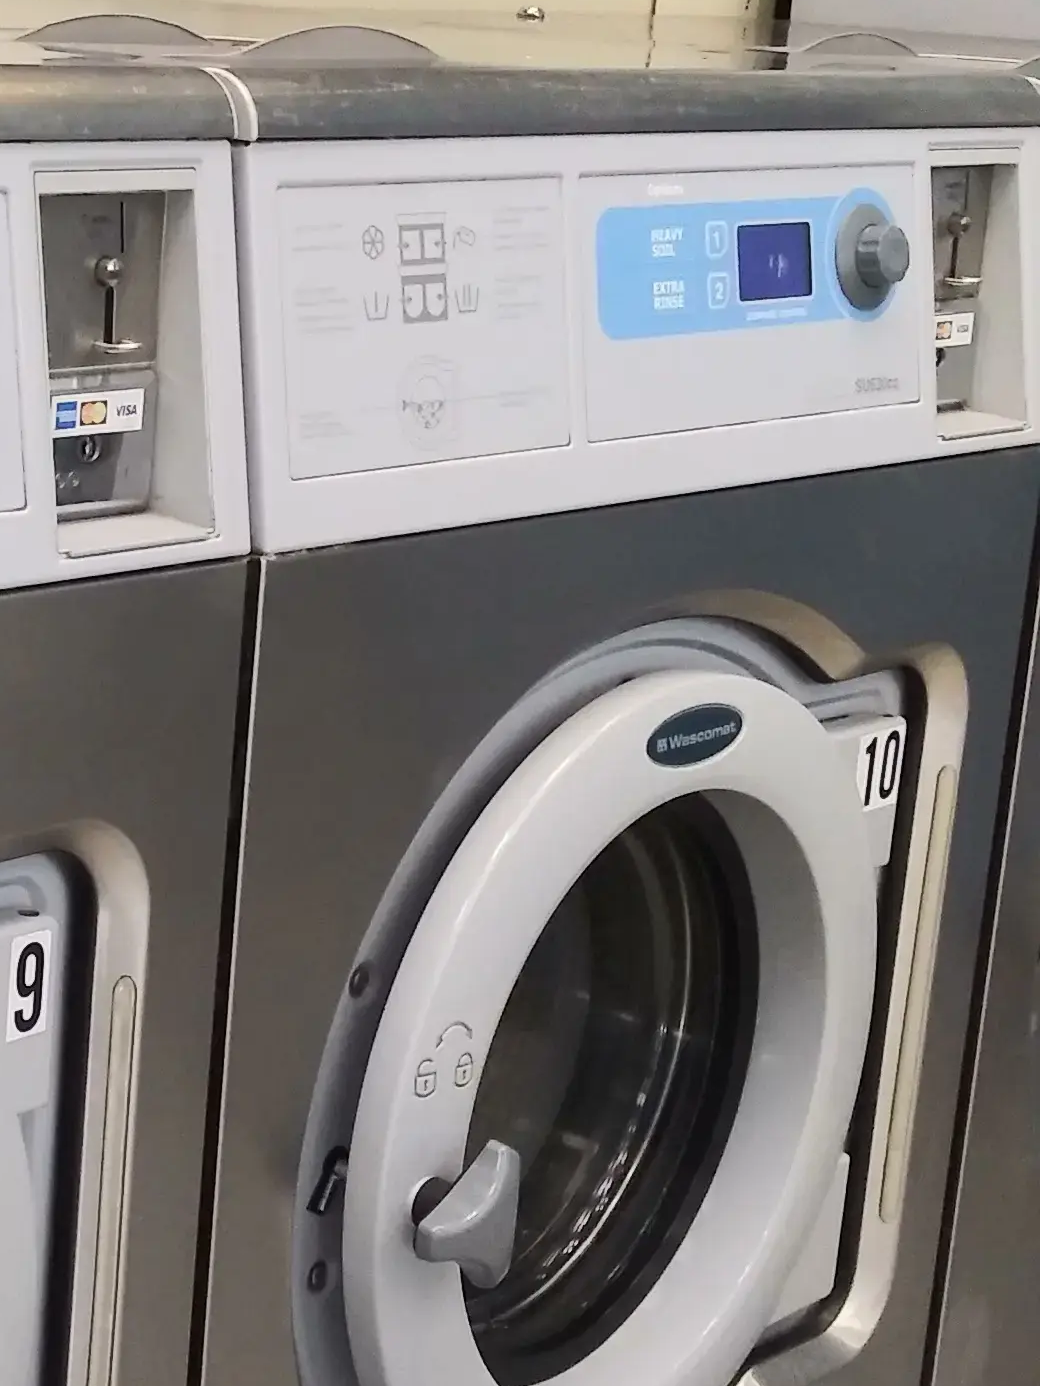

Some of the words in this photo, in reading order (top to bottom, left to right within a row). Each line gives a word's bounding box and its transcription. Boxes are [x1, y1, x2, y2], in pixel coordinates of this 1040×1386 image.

[650, 227, 684, 243] HEAVY
[653, 280, 685, 295] EXTRA
[714, 282, 724, 300] 2
[653, 295, 685, 310] RINSE
[116, 404, 138, 417] VISA
[667, 720, 737, 750] Wascomat
[865, 729, 900, 806] 10
[14, 941, 45, 1033] 9
